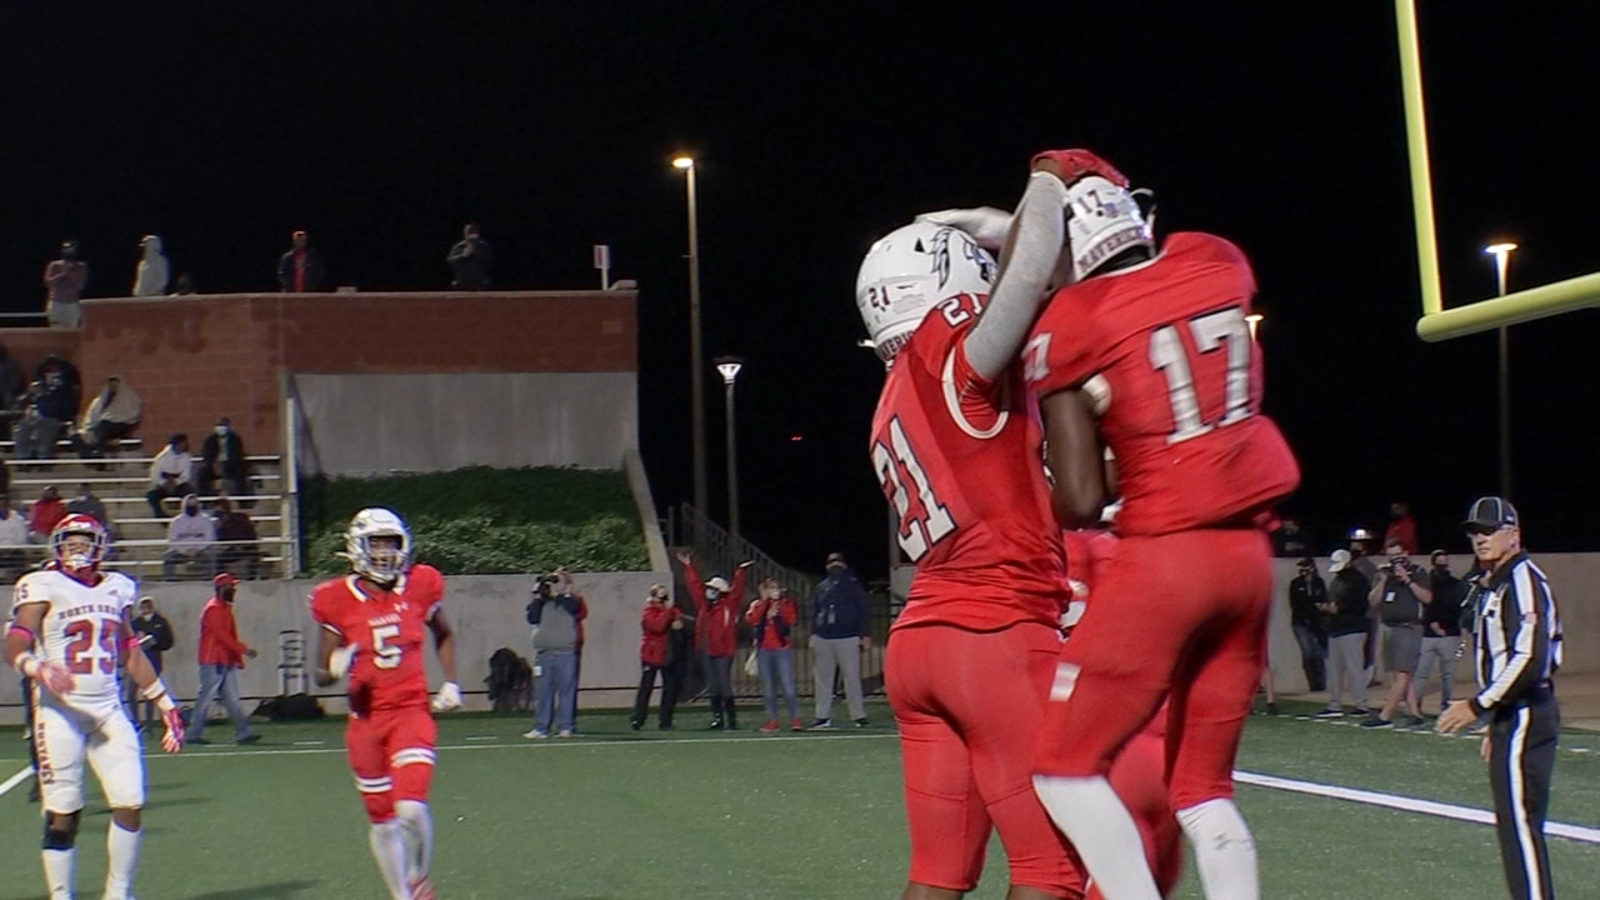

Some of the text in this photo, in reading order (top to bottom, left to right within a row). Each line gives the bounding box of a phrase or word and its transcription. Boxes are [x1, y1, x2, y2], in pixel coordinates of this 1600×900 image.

[1077, 189, 1103, 214] 17
[868, 285, 890, 309] 21
[936, 292, 983, 328] 21
[1149, 304, 1255, 445] 17
[871, 413, 958, 563] 21
[64, 618, 121, 675] 25
[372, 624, 403, 669] 5
